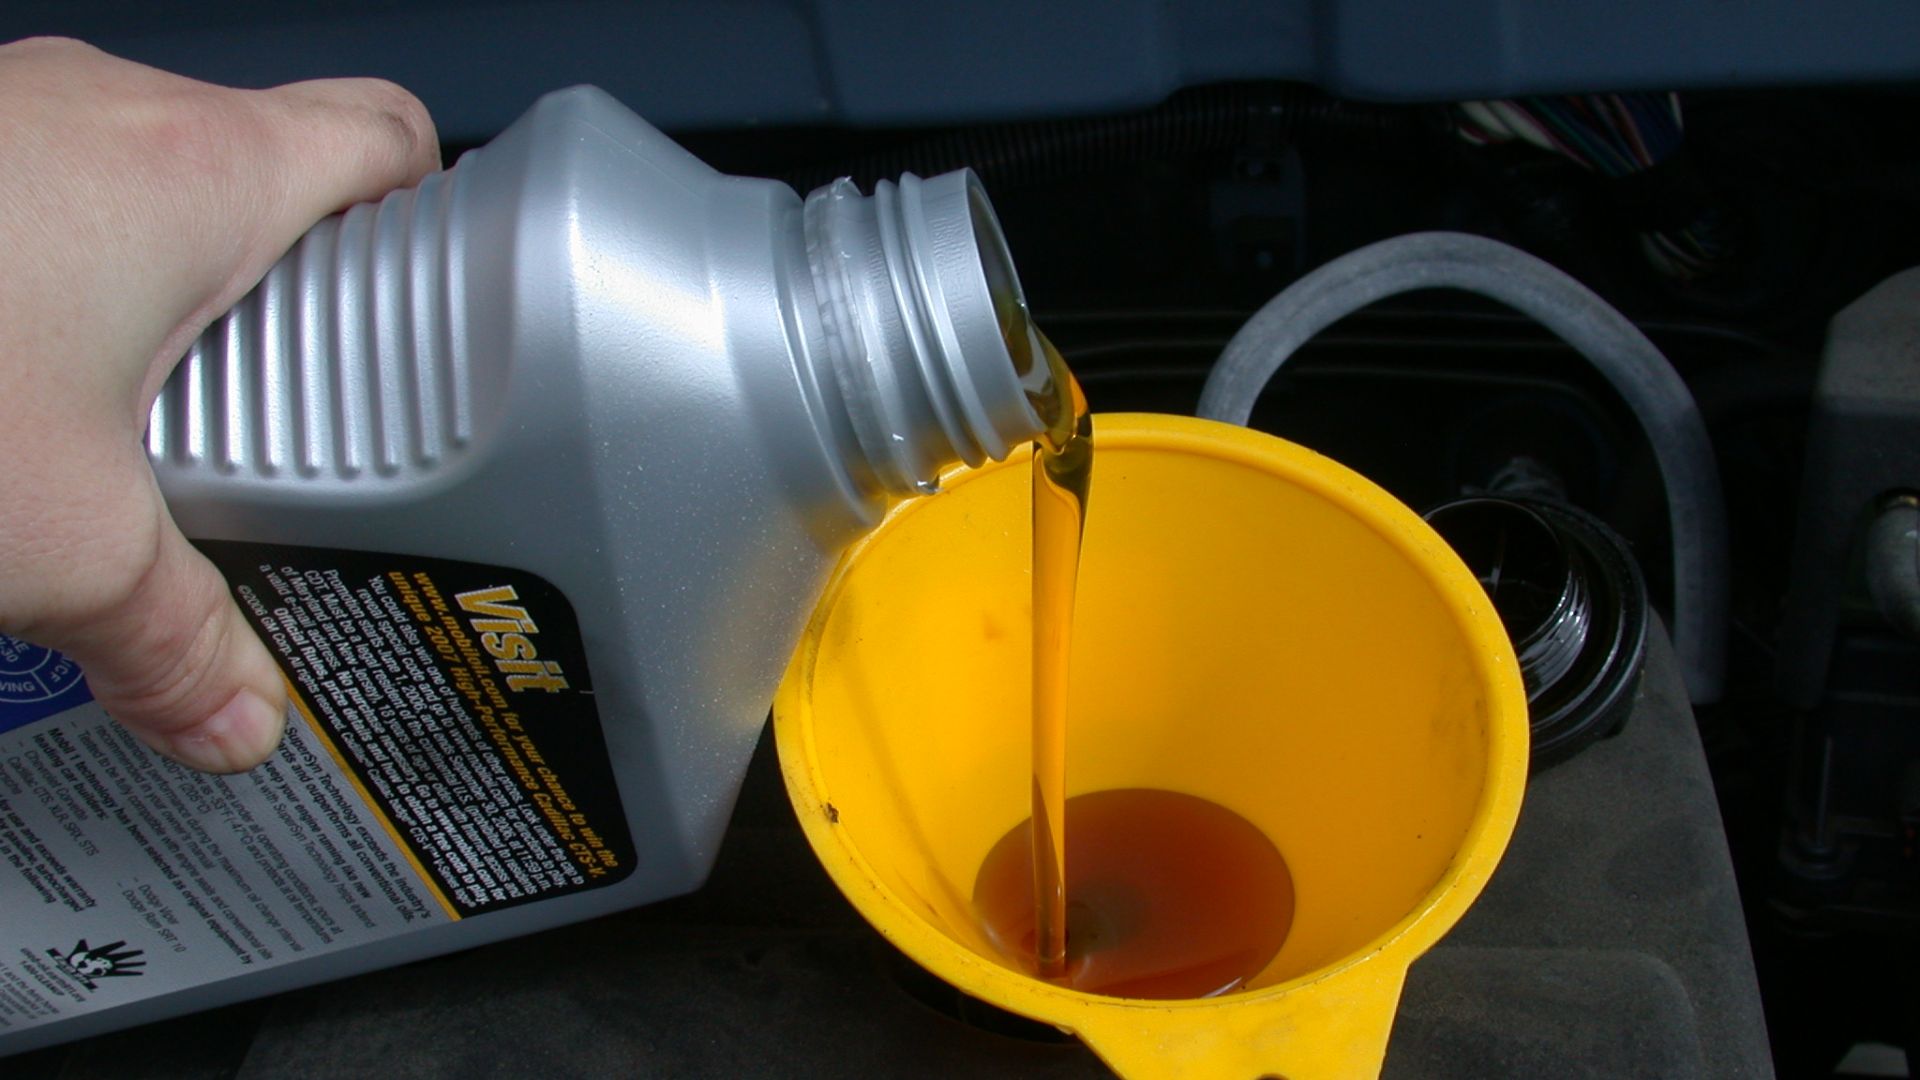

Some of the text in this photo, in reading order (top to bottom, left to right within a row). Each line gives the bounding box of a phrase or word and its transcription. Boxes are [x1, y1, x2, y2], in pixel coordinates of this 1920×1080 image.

[258, 563, 272, 572] a
[265, 571, 293, 598] valid
[282, 595, 316, 631] e-mail
[319, 592, 349, 623] Must
[355, 585, 387, 621] reveal
[338, 619, 358, 637] be
[348, 635, 361, 644] a
[373, 617, 411, 660] special
[453, 583, 570, 692] Visit
[259, 615, 321, 695] GM All rights
[352, 642, 381, 671] legal
[400, 655, 428, 684] code
[334, 669, 356, 687] No
[371, 668, 407, 708] resident
[417, 681, 441, 704] and
[323, 567, 367, 619] Promotion
[356, 617, 386, 649] starts
[375, 646, 403, 674] June
[419, 711, 443, 734] and
[432, 730, 458, 755] ends
[446, 752, 491, 804] September
[507, 838, 525, 850] at
[343, 684, 389, 736] purchase
[386, 568, 434, 625] unique
[423, 623, 461, 666] 2007
[447, 664, 543, 792] High-Performance
[533, 789, 579, 841] Cadillac
[398, 707, 416, 721] of
[411, 570, 622, 869] www.mobiloil.com for your chance to win the
[428, 701, 447, 719] go
[281, 564, 525, 900] of Maryland and New 18 years of age or older with Internet access and
[368, 574, 587, 886] You could also win one of hundreds of other Look under the cap to
[406, 719, 427, 737] the
[439, 715, 457, 728] to
[46, 727, 76, 755] Mobil
[272, 606, 493, 908] Official Rules, prize details and how to obtain a free code to play.
[29, 734, 77, 784] leading car
[447, 726, 513, 808] www.mobiloil.com
[72, 761, 120, 811] technology
[281, 726, 325, 775] SuperSyn
[315, 773, 363, 828] Technology
[355, 825, 390, 862] exceeds
[381, 861, 402, 878] the
[415, 783, 435, 799] Go
[424, 796, 442, 809] to
[111, 807, 133, 825] has
[260, 760, 372, 901] keep your engine running like new
[503, 806, 522, 822] for
[76, 839, 99, 858] STS
[125, 824, 151, 847] been
[290, 763, 405, 906] and outperforms all conventional
[432, 807, 499, 889] www.mobiloil.com
[511, 818, 550, 861] directions
[6, 811, 25, 828] use
[19, 825, 42, 845] and
[33, 841, 70, 875] exceeds
[60, 873, 101, 908] warranty
[143, 845, 180, 880] selected
[497, 847, 514, 860] to
[540, 858, 557, 870] to
[171, 879, 186, 890] as
[503, 857, 539, 896] residents
[178, 888, 215, 921] original
[488, 886, 509, 903] for
[204, 917, 248, 959] equipment
[237, 954, 256, 967] by
